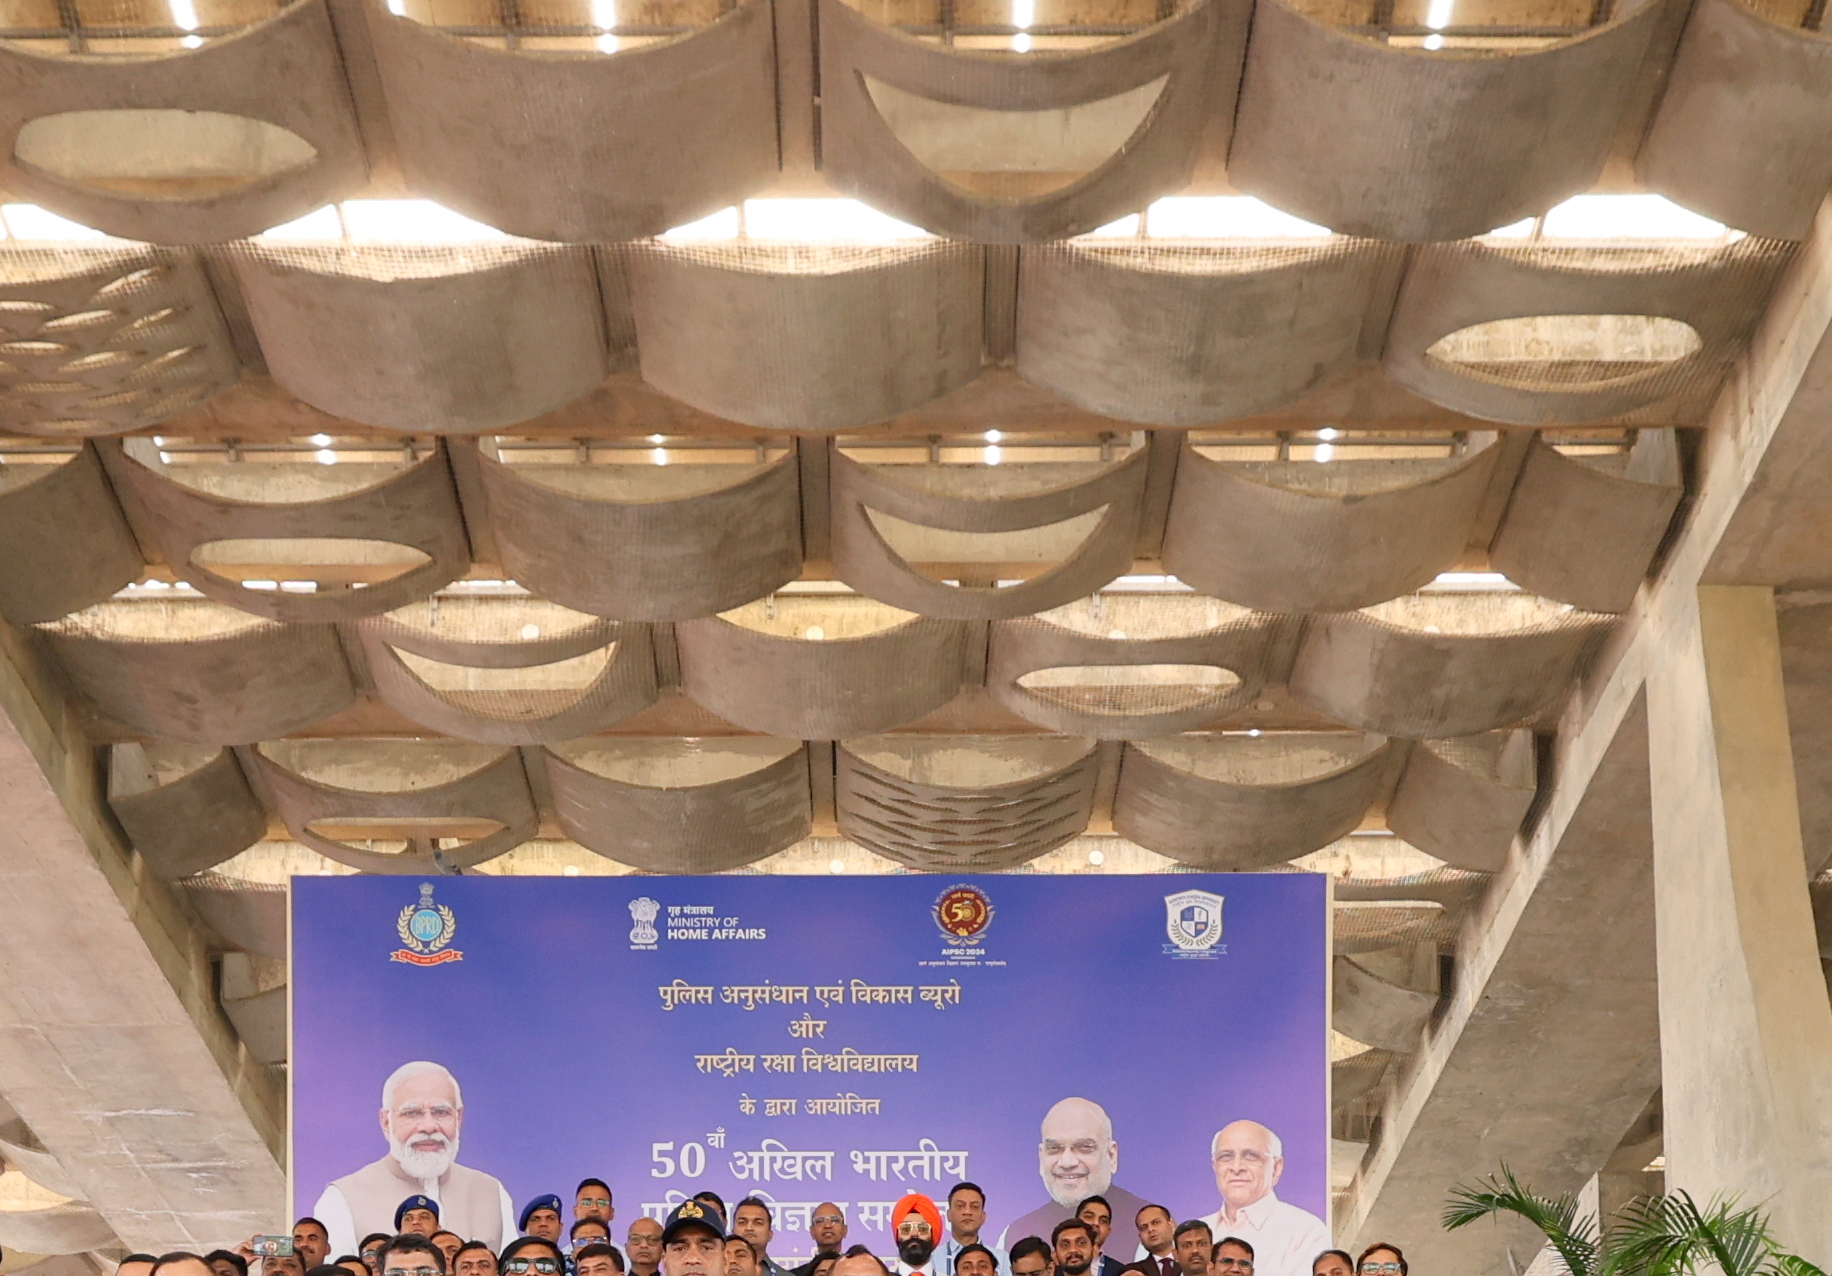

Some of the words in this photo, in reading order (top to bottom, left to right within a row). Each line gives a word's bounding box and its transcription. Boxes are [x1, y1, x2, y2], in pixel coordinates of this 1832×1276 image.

[667, 905, 681, 917] गृह
[682, 904, 715, 915] मंत्रालय
[667, 917, 721, 928] MINISTRY
[723, 917, 739, 928] OF
[667, 928, 709, 940] HOME
[712, 928, 767, 940] AFFAIRS
[965, 948, 986, 956] 2024
[658, 978, 714, 1011] पुलिस
[719, 979, 809, 1011] अनुसंधान
[814, 979, 845, 1008] एवं
[849, 978, 914, 1005] विकास
[919, 978, 963, 1011] ब्यूरो
[787, 1012, 827, 1039] और
[694, 1047, 756, 1077] राष्ट्रीय
[760, 1054, 796, 1074] रक्षा
[801, 1047, 919, 1074] विश्वविद्यालय
[739, 1092, 757, 1116] के
[764, 1098, 798, 1117] द्वारा
[804, 1092, 881, 1116] आयोजित
[728, 1138, 835, 1182] अखिल
[849, 1138, 970, 1182] भारतीय
